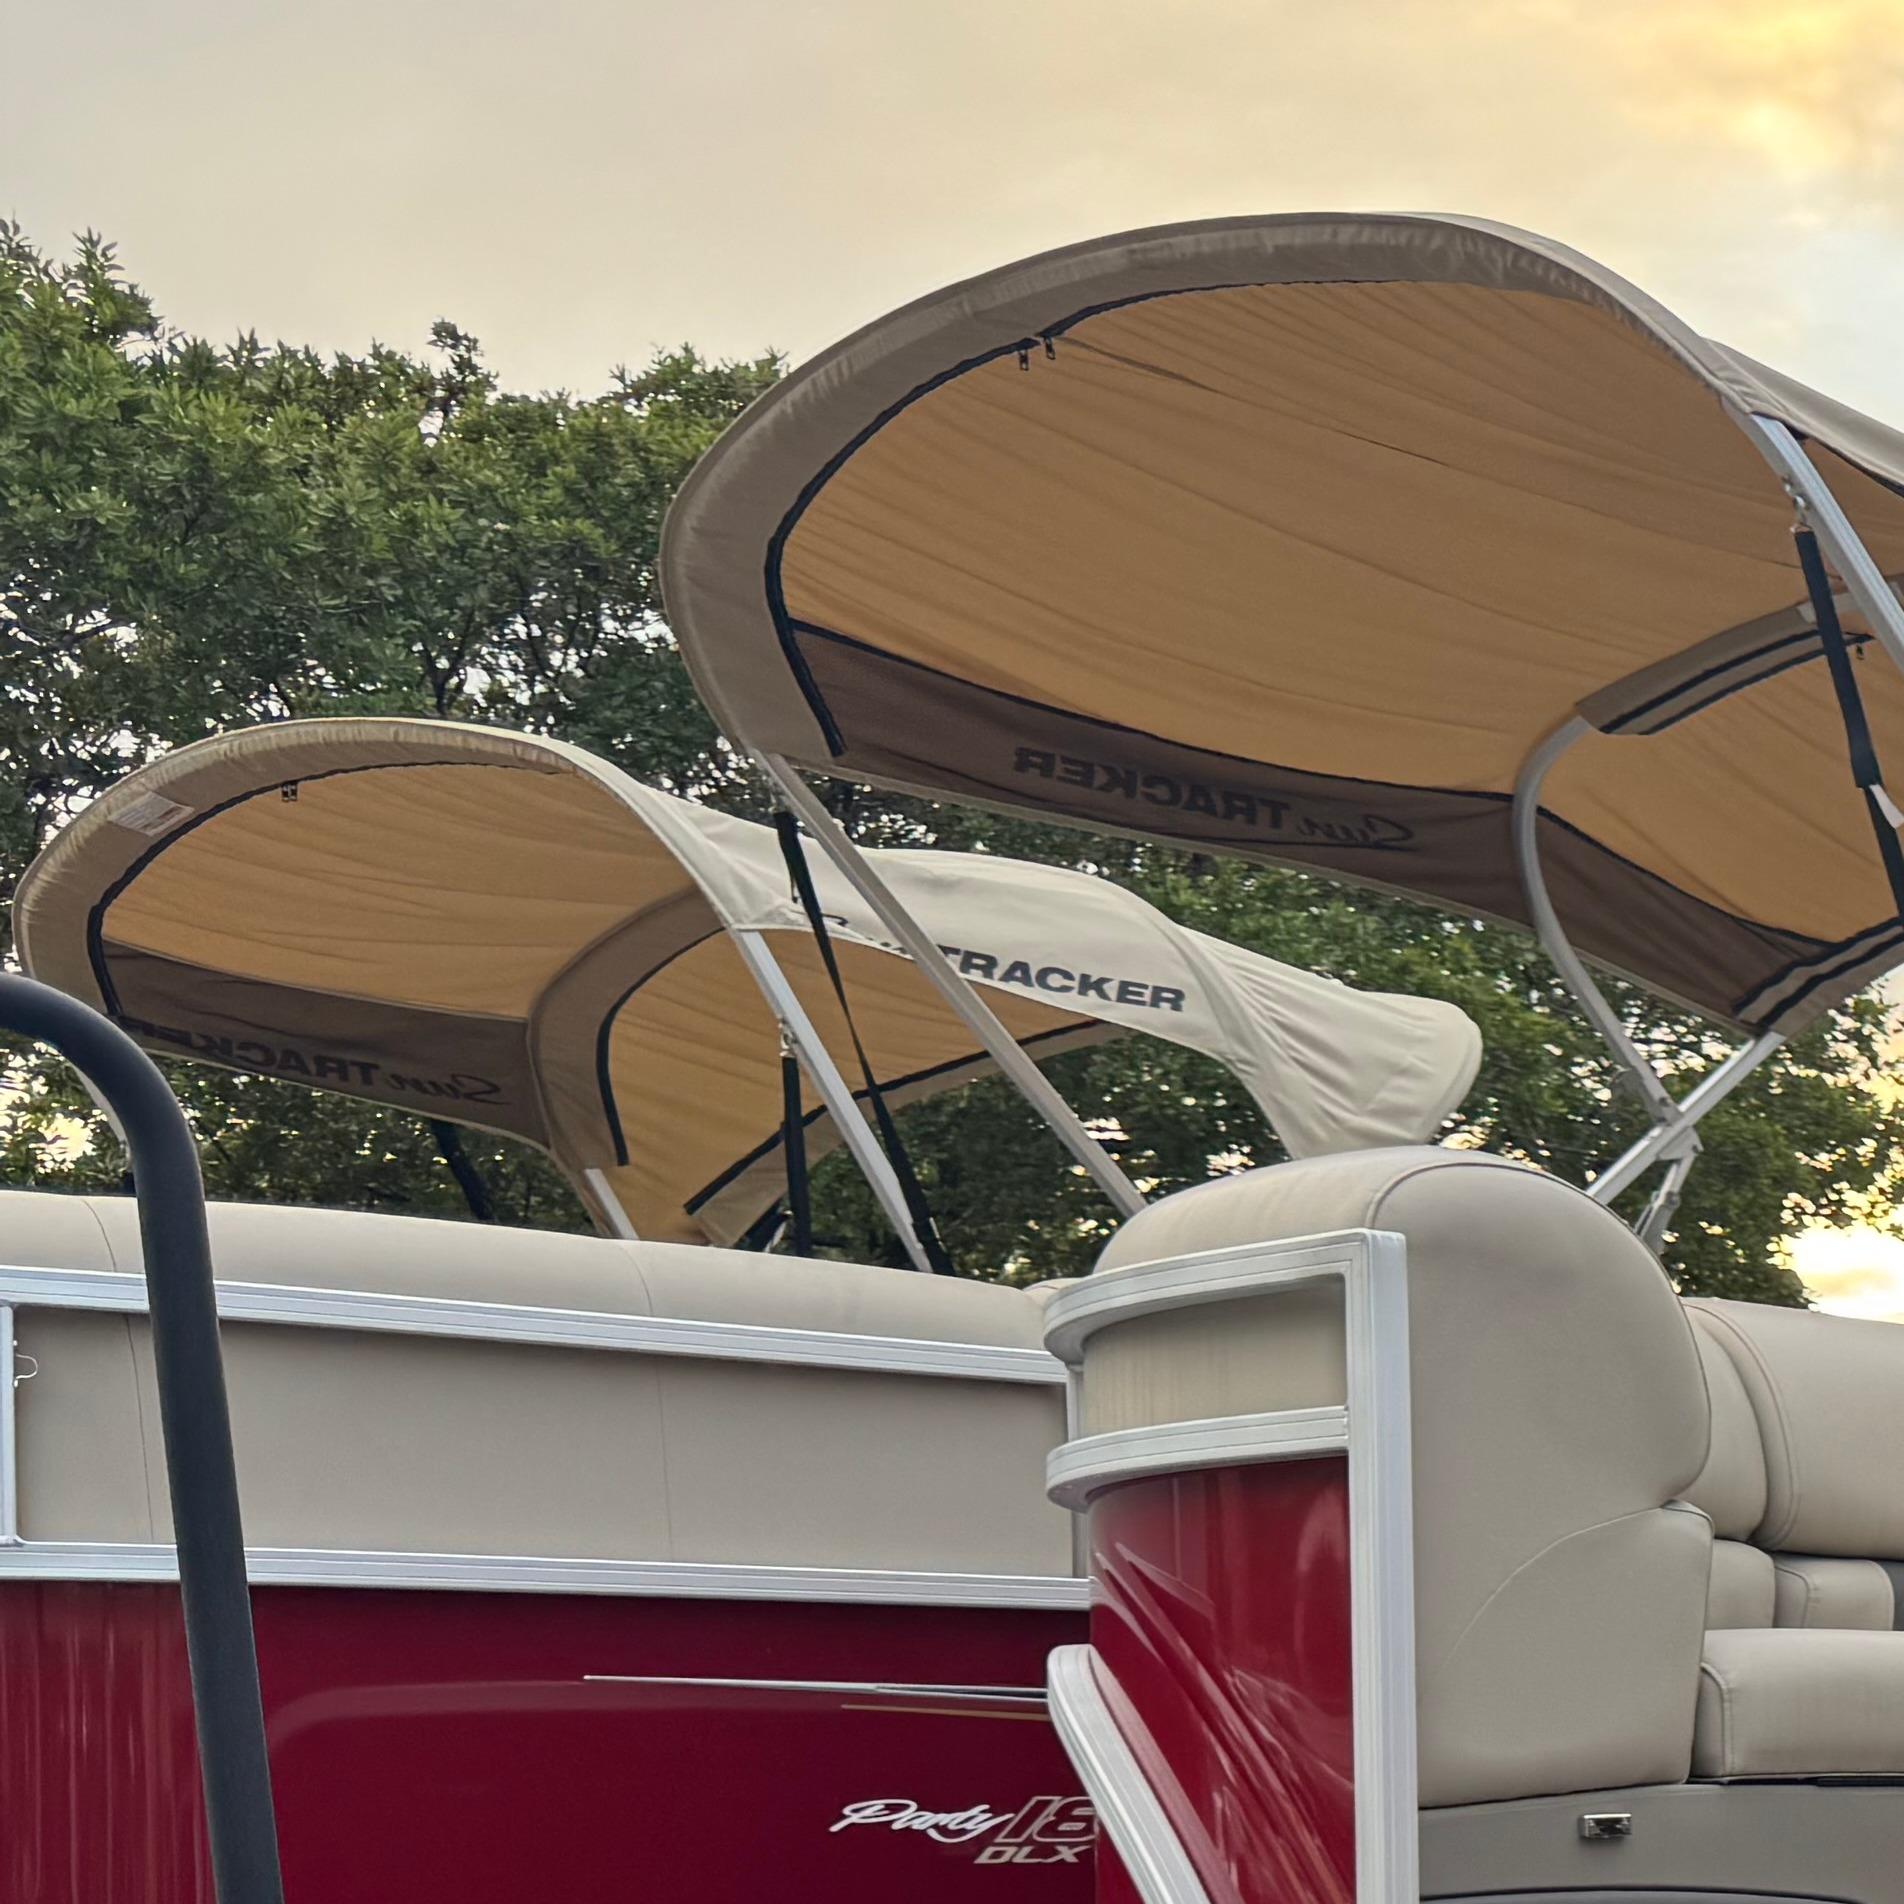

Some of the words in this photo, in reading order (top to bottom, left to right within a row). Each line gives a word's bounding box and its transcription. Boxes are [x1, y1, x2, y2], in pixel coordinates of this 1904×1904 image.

[829, 1798, 1016, 1843] Party
[993, 1796, 1098, 1843] 18
[973, 1845, 1092, 1864] DLX
